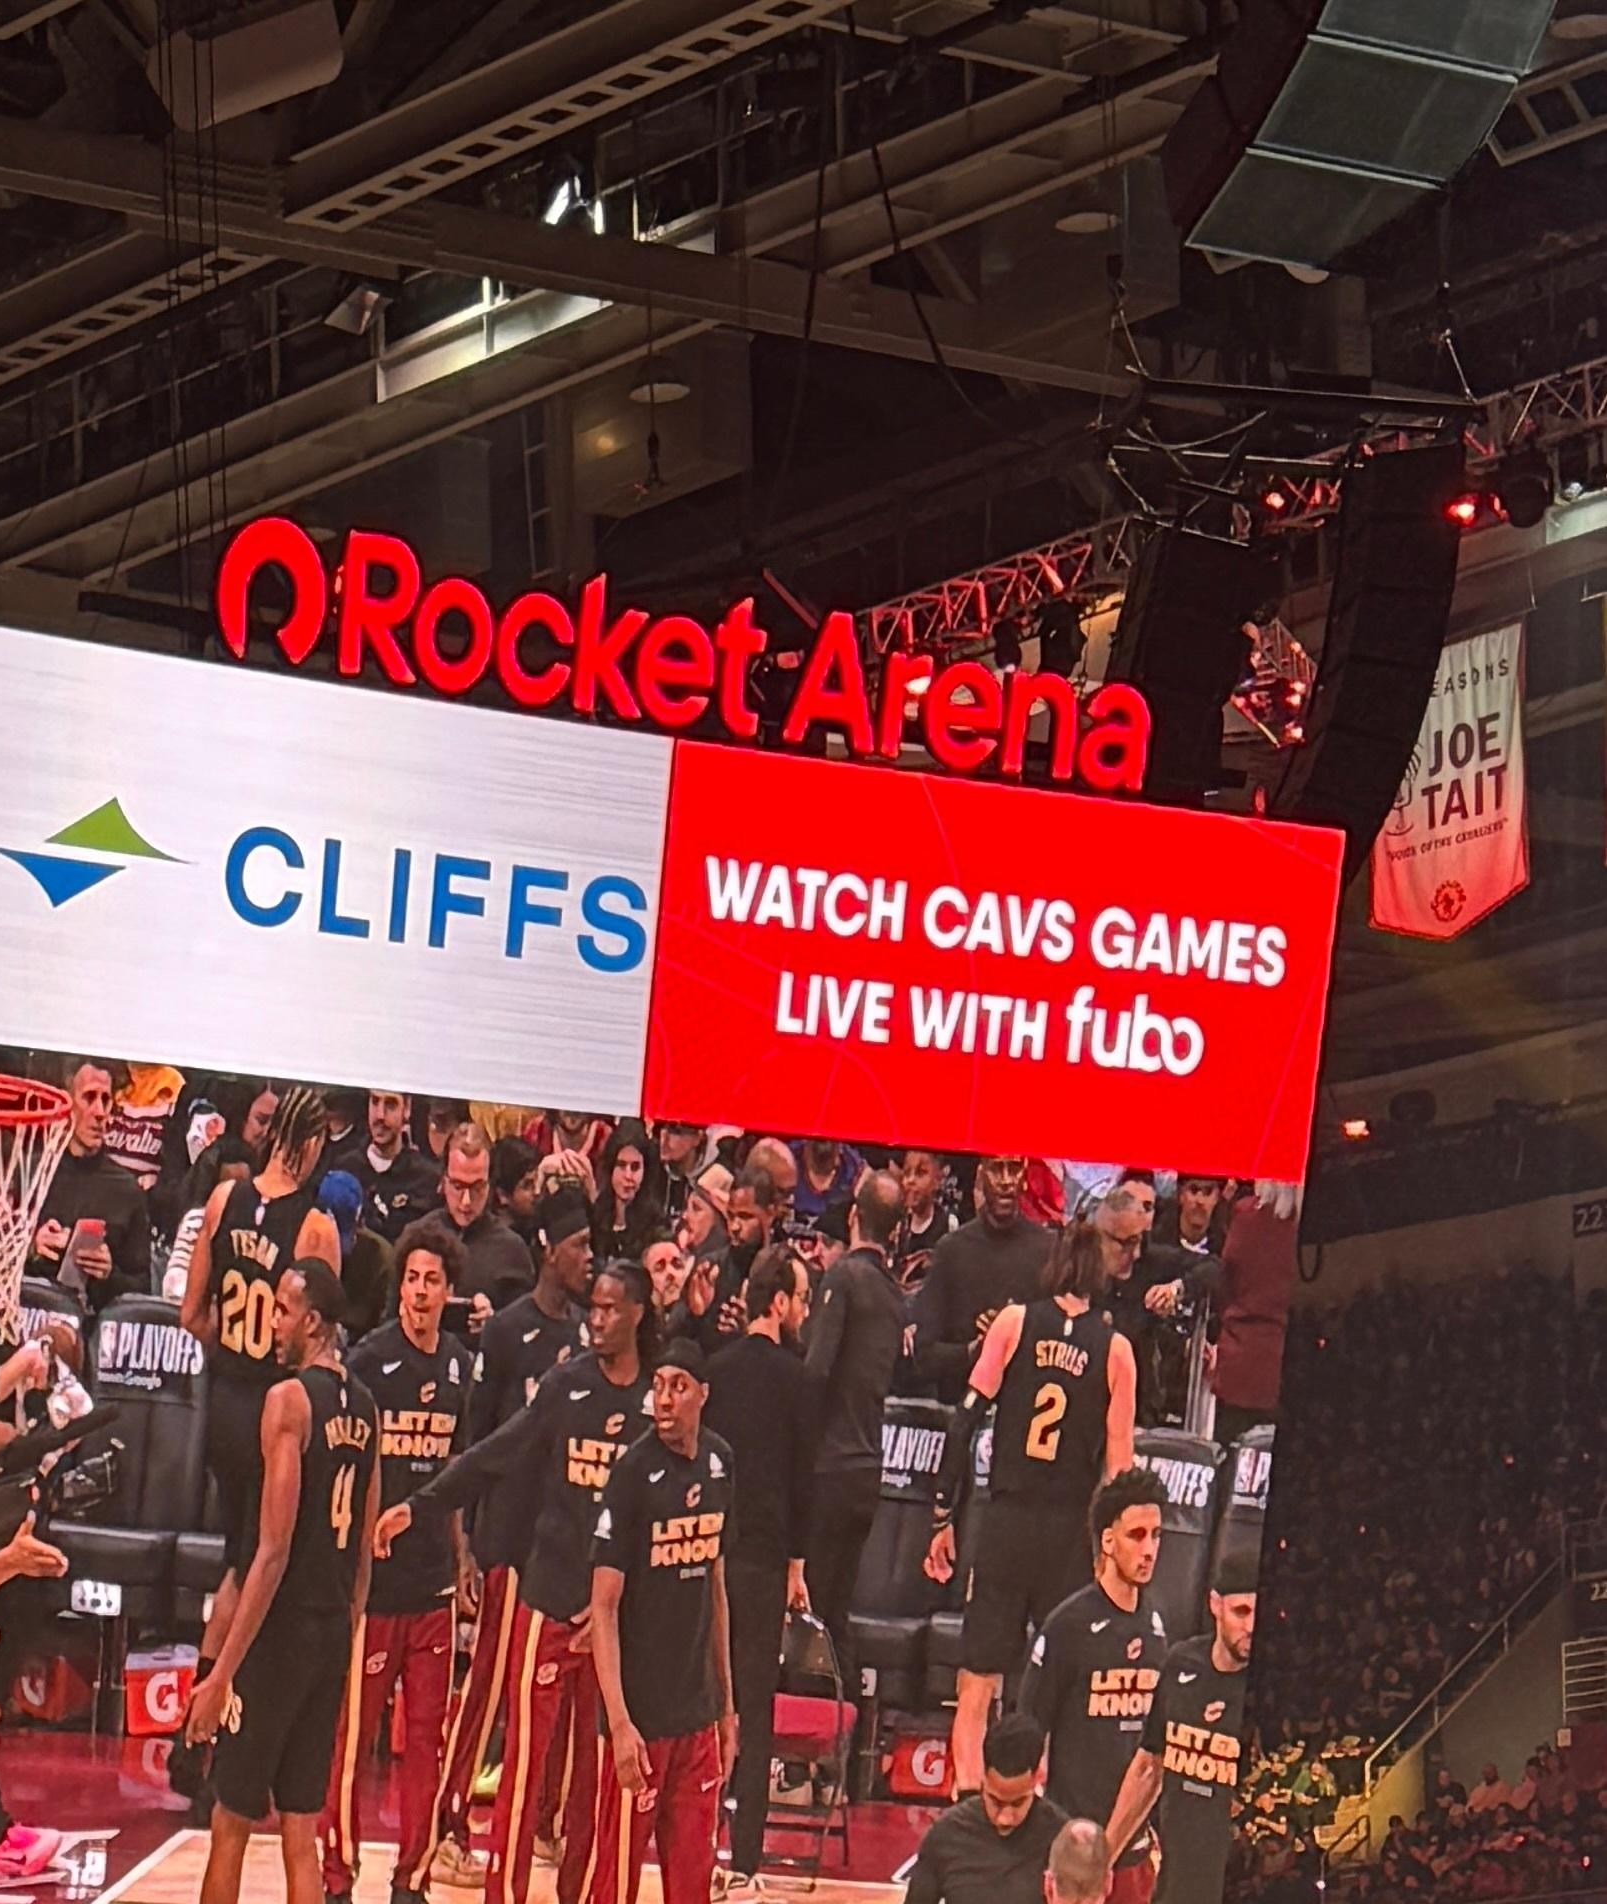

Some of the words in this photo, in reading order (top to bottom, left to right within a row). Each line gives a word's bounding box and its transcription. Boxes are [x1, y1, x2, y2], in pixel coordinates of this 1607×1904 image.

[337, 529, 769, 739] Rocket
[781, 611, 1151, 792] Arena
[1430, 658, 1511, 699] EASONS
[1427, 711, 1501, 777] JOE
[1420, 763, 1508, 830] TAIT
[223, 825, 649, 975] CLIFFS
[705, 854, 909, 943] WATCH
[923, 884, 1076, 964] CAVS
[1091, 906, 1288, 988] GAMES
[775, 970, 895, 1045] LIVE
[909, 985, 1048, 1061] WITH
[1065, 985, 1204, 1076] fubo
[116, 1322, 203, 1375] PLAYOFFS
[220, 1268, 275, 1361] 20
[1026, 1382, 1068, 1461] 2
[329, 1463, 356, 1550] 4
